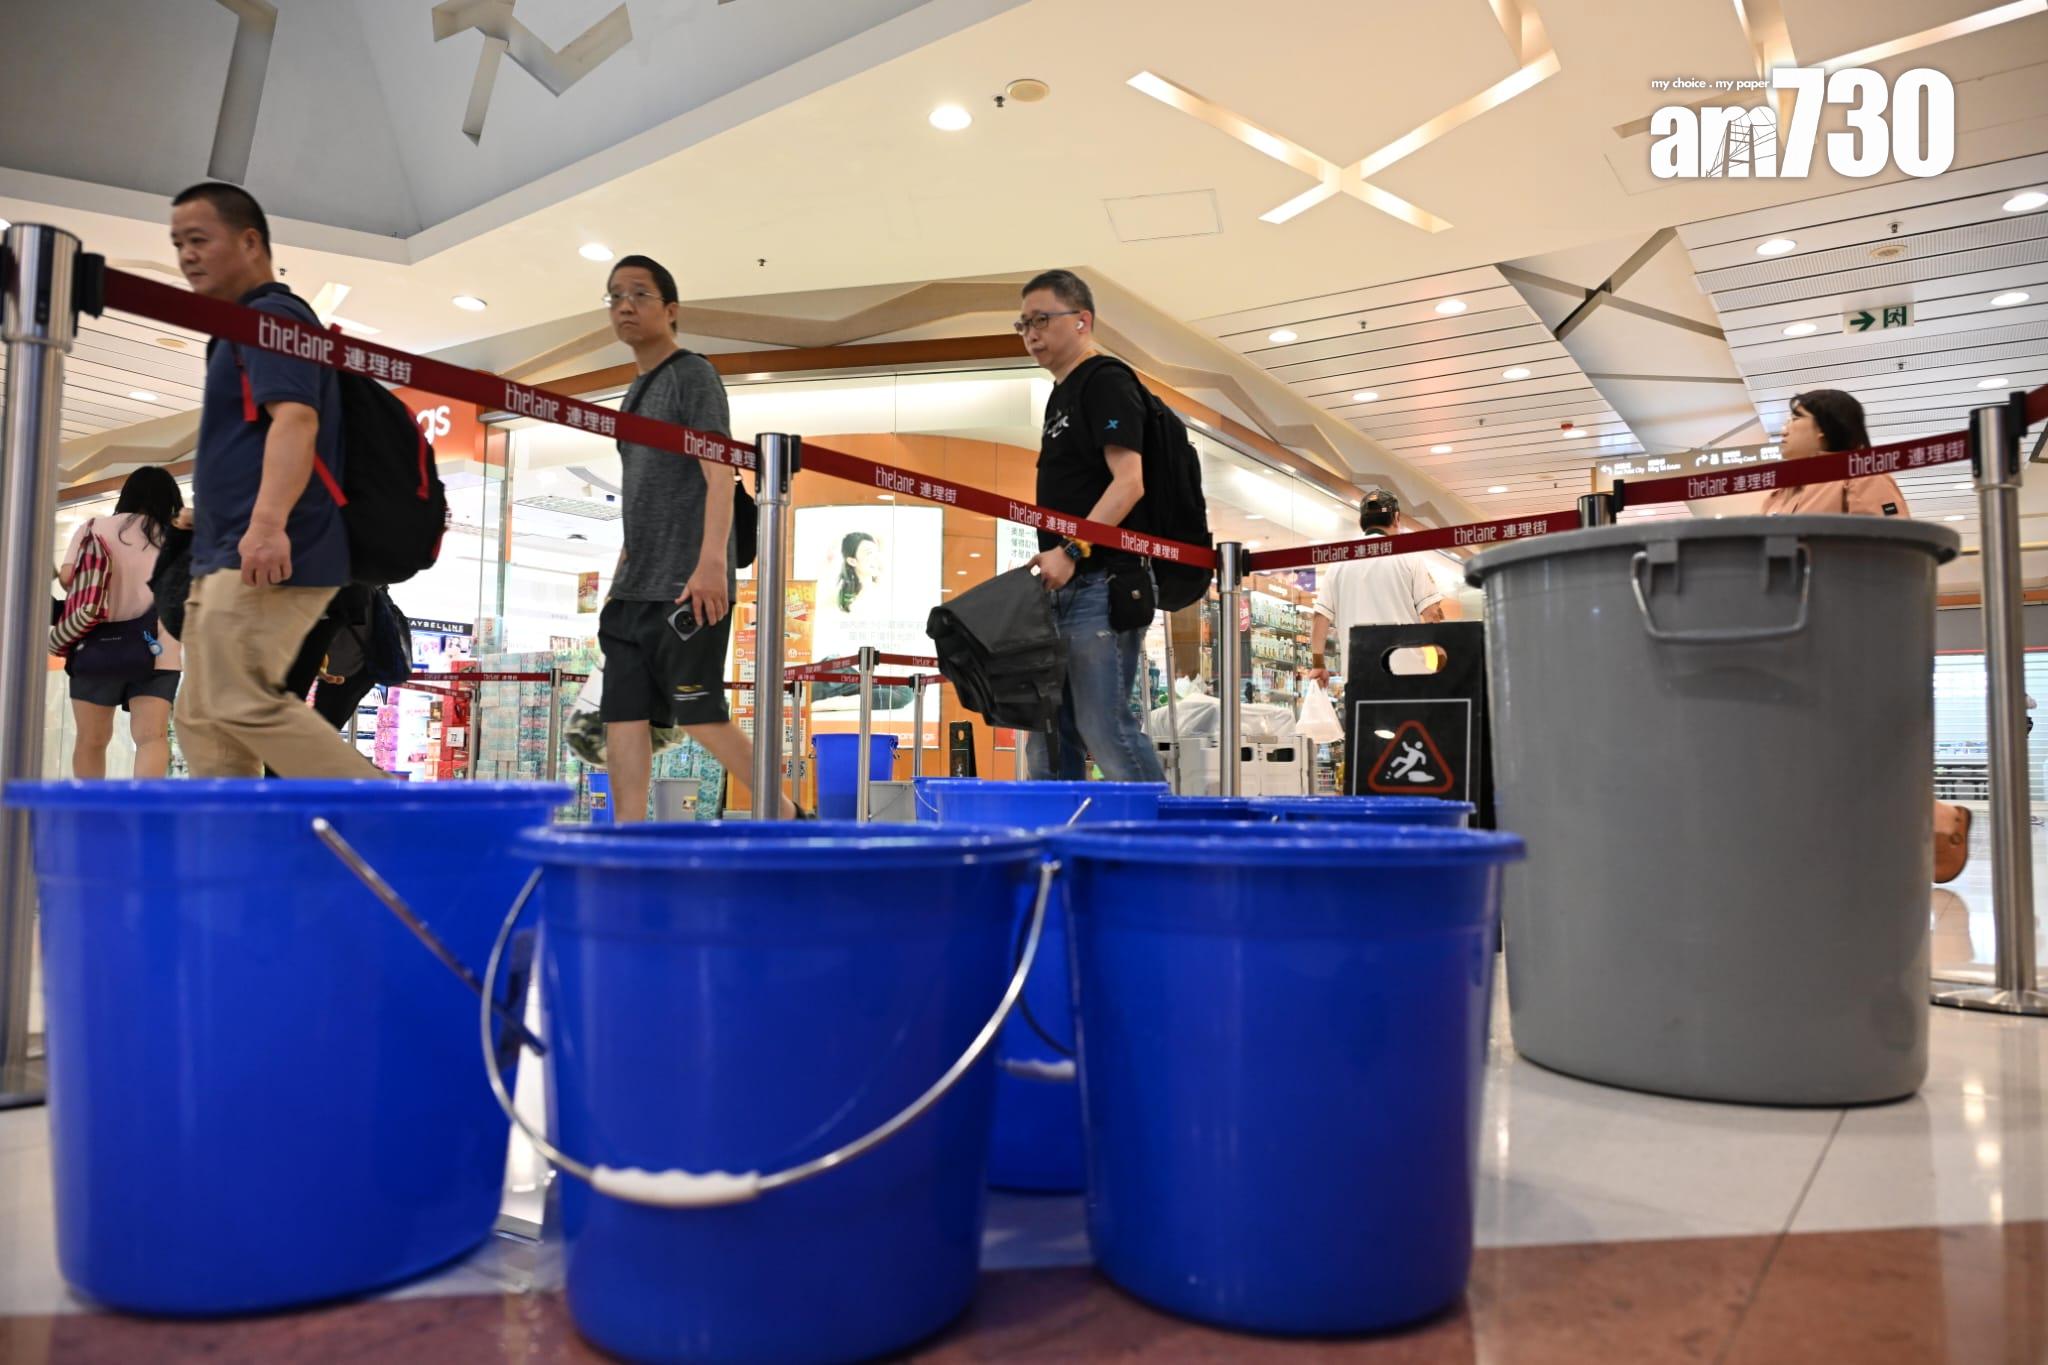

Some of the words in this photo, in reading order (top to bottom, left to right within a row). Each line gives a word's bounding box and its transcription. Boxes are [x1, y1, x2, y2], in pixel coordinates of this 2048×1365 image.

[258, 314, 335, 365] thelane
[343, 345, 413, 385] 連理街
[505, 383, 560, 422] thelane
[566, 405, 617, 436] 連理街
[1849, 447, 1900, 478] thelane
[1907, 439, 1965, 467] 連理街
[875, 466, 915, 495] thelane
[919, 481, 957, 504] 連理街
[1688, 475, 1728, 499] thelane
[1009, 501, 1042, 528] thelane
[1121, 531, 1150, 555] thelane
[1454, 524, 1497, 546] thelane
[1502, 520, 1548, 538] 連理街
[1312, 545, 1349, 564] thelane
[408, 620, 464, 633] AYBELLINE
